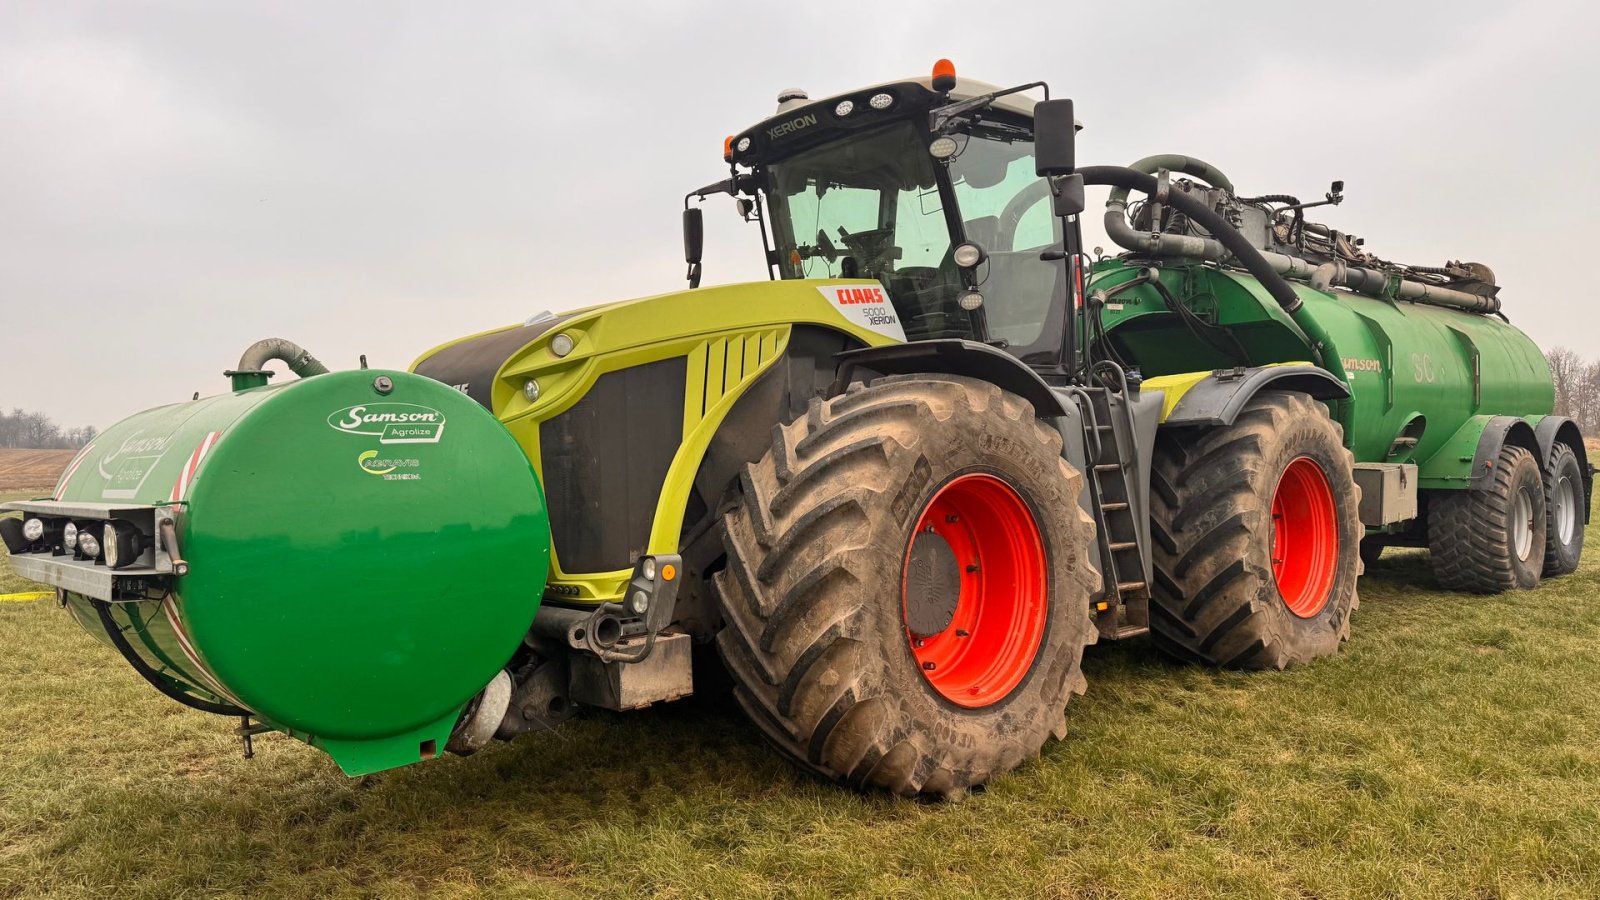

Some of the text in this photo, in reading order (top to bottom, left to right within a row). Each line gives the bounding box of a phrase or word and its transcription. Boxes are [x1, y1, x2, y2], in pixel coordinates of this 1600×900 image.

[766, 113, 818, 141] XERION
[836, 288, 884, 305] CLAAS
[862, 307, 886, 317] 5000
[868, 315, 896, 326] XERION
[339, 406, 437, 429] Samson
[391, 428, 431, 437] Agrolize
